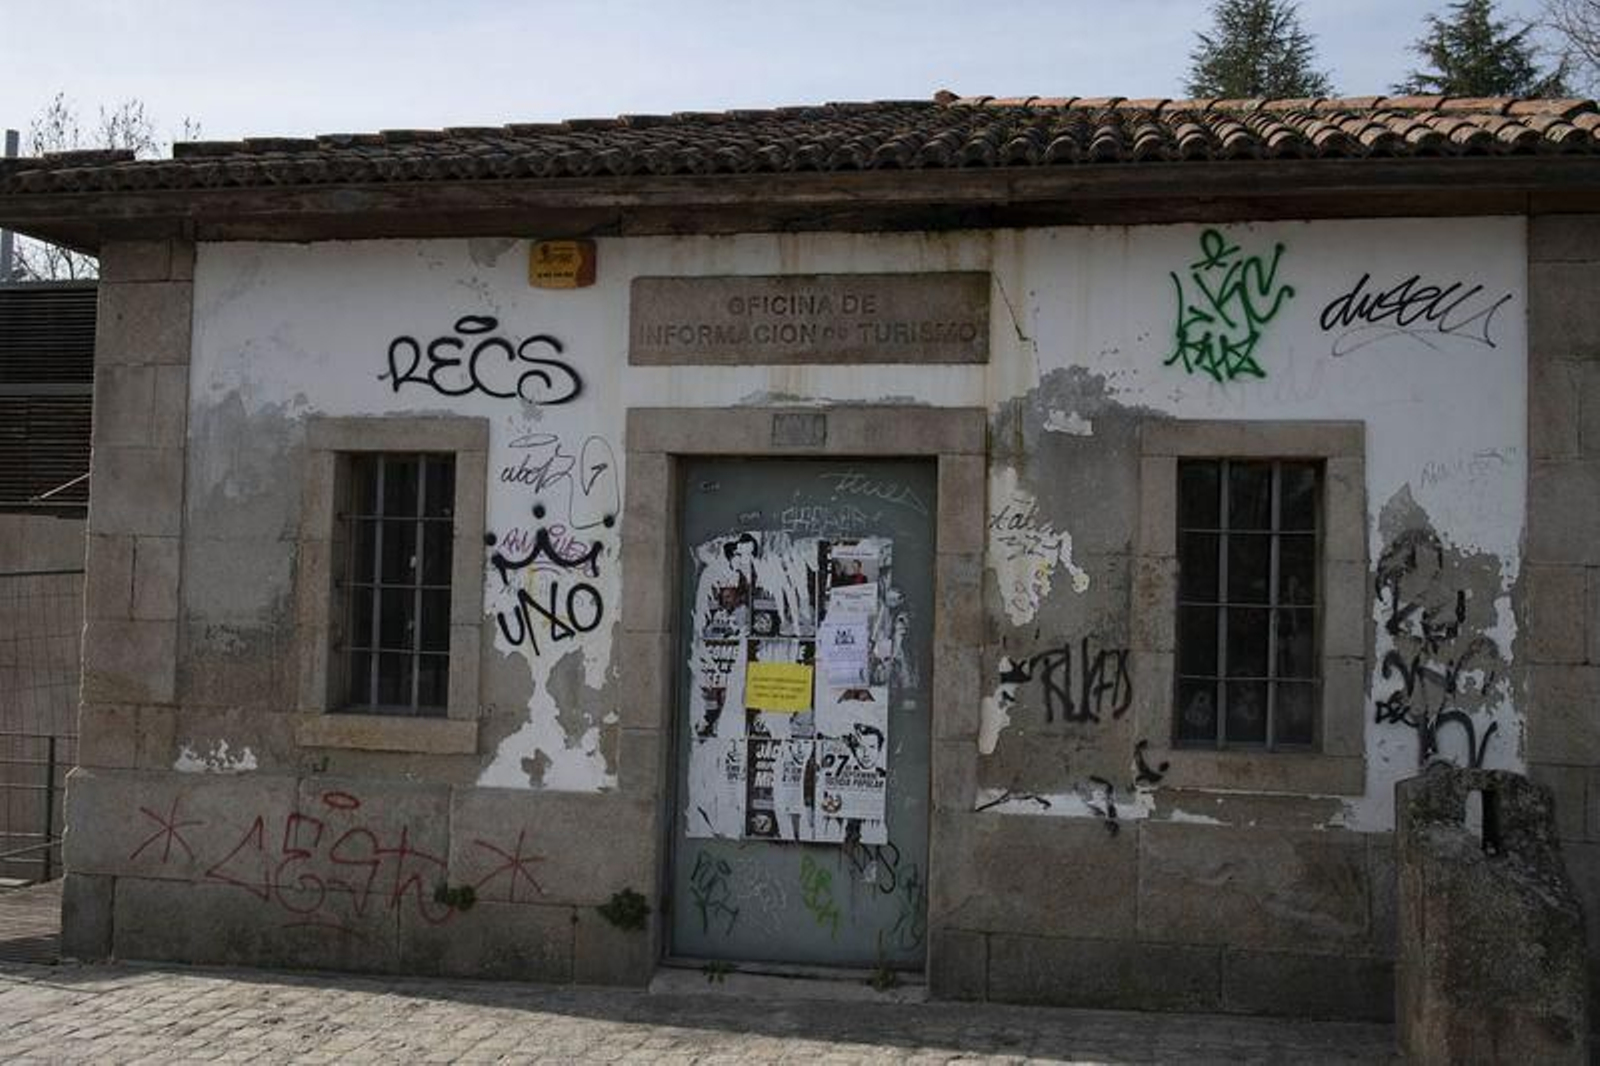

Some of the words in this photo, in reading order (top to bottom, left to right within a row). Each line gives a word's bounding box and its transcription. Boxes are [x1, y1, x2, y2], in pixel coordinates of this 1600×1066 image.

[727, 294, 834, 317] OFICINA
[842, 292, 877, 315] DE
[639, 323, 817, 346] INFORMACION
[857, 321, 977, 343] TURISMO
